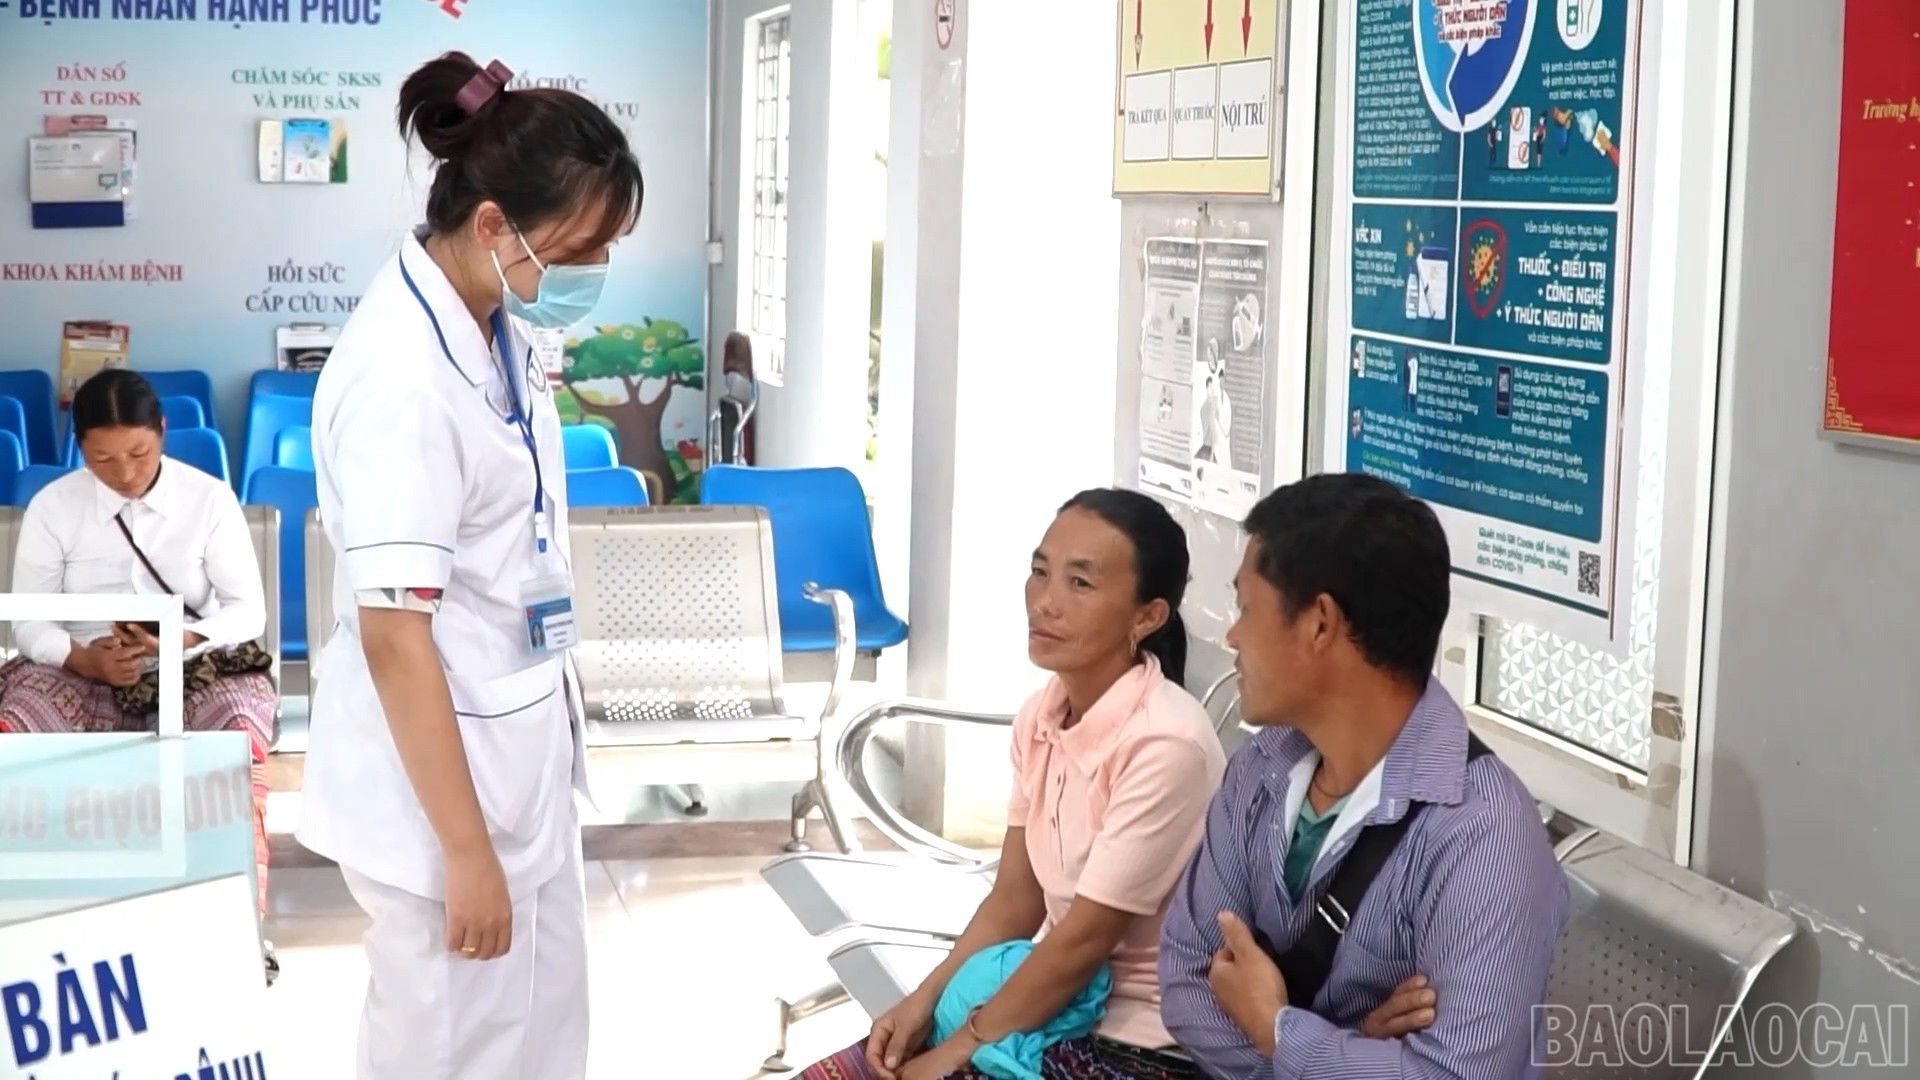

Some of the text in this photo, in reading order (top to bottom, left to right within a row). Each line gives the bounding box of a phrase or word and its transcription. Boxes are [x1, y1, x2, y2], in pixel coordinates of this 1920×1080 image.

[57, 61, 126, 81] DÂN SỐ
[232, 66, 382, 87] CHĂM SÓC SKSS
[40, 91, 141, 106] TT & GDSK
[253, 91, 360, 113] VÀ PHỤ SẢN
[1862, 98, 1907, 123] Trường
[1222, 94, 1266, 132] NỘI TRÚ
[1579, 239, 1597, 252] pháp
[2, 259, 183, 286] KHOA KHÁM BỆNH
[268, 258, 346, 283] HỒI SỨC
[1518, 251, 1551, 276] THUỐC
[1561, 253, 1586, 278] ĐIỀU
[1589, 262, 1606, 284] TRỊ
[245, 287, 283, 312] CẤP
[288, 291, 328, 313] CỨU
[1546, 280, 1573, 303] CÔNG
[1576, 284, 1605, 310] NGHỆ
[1504, 301, 1511, 322] Ý
[1514, 302, 1541, 325] THỨC
[1543, 306, 1578, 329] NGƯỜI
[1580, 309, 1604, 332] DÂN
[1567, 336, 1584, 349] pháp
[1585, 337, 1603, 350] khác
[1, 952, 148, 1068] BÀN
